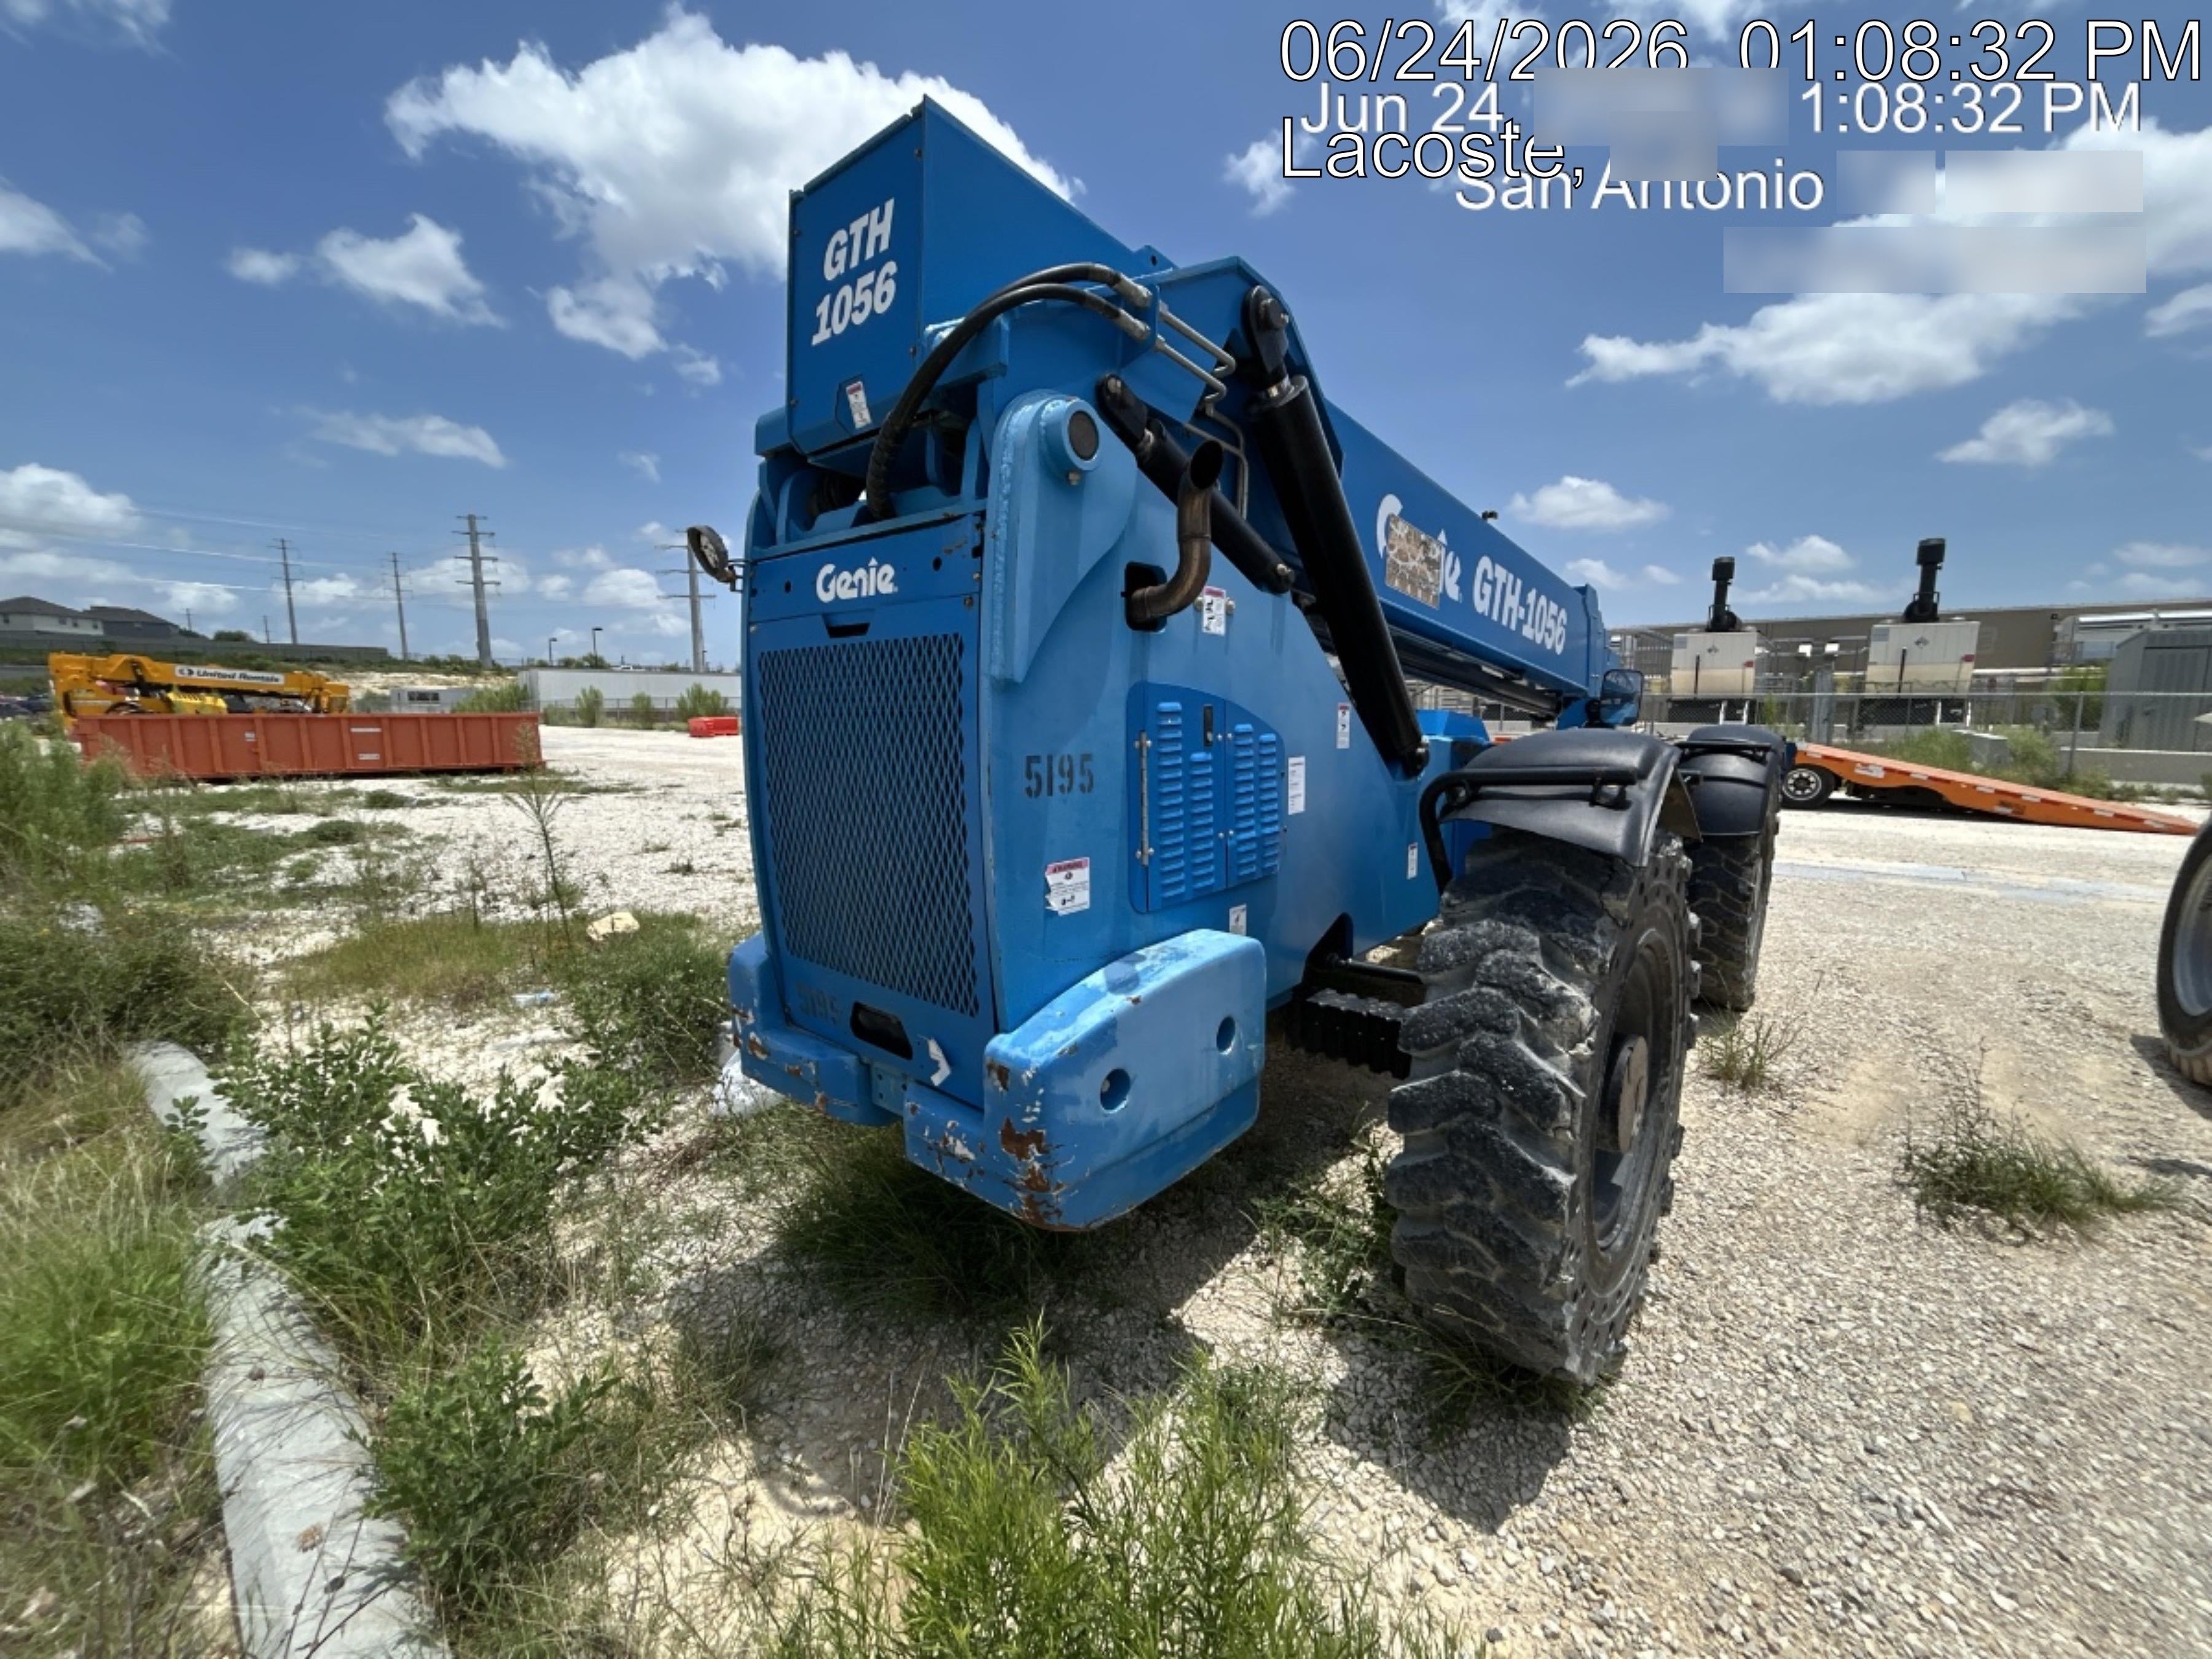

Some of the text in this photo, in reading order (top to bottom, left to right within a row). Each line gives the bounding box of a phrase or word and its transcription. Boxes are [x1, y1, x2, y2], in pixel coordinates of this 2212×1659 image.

[823, 197, 895, 282] GTH
[811, 260, 898, 347] 1056
[816, 556, 895, 603] Genie
[1473, 555, 1567, 655] GTH-1056
[1024, 753, 1094, 798] 5195
